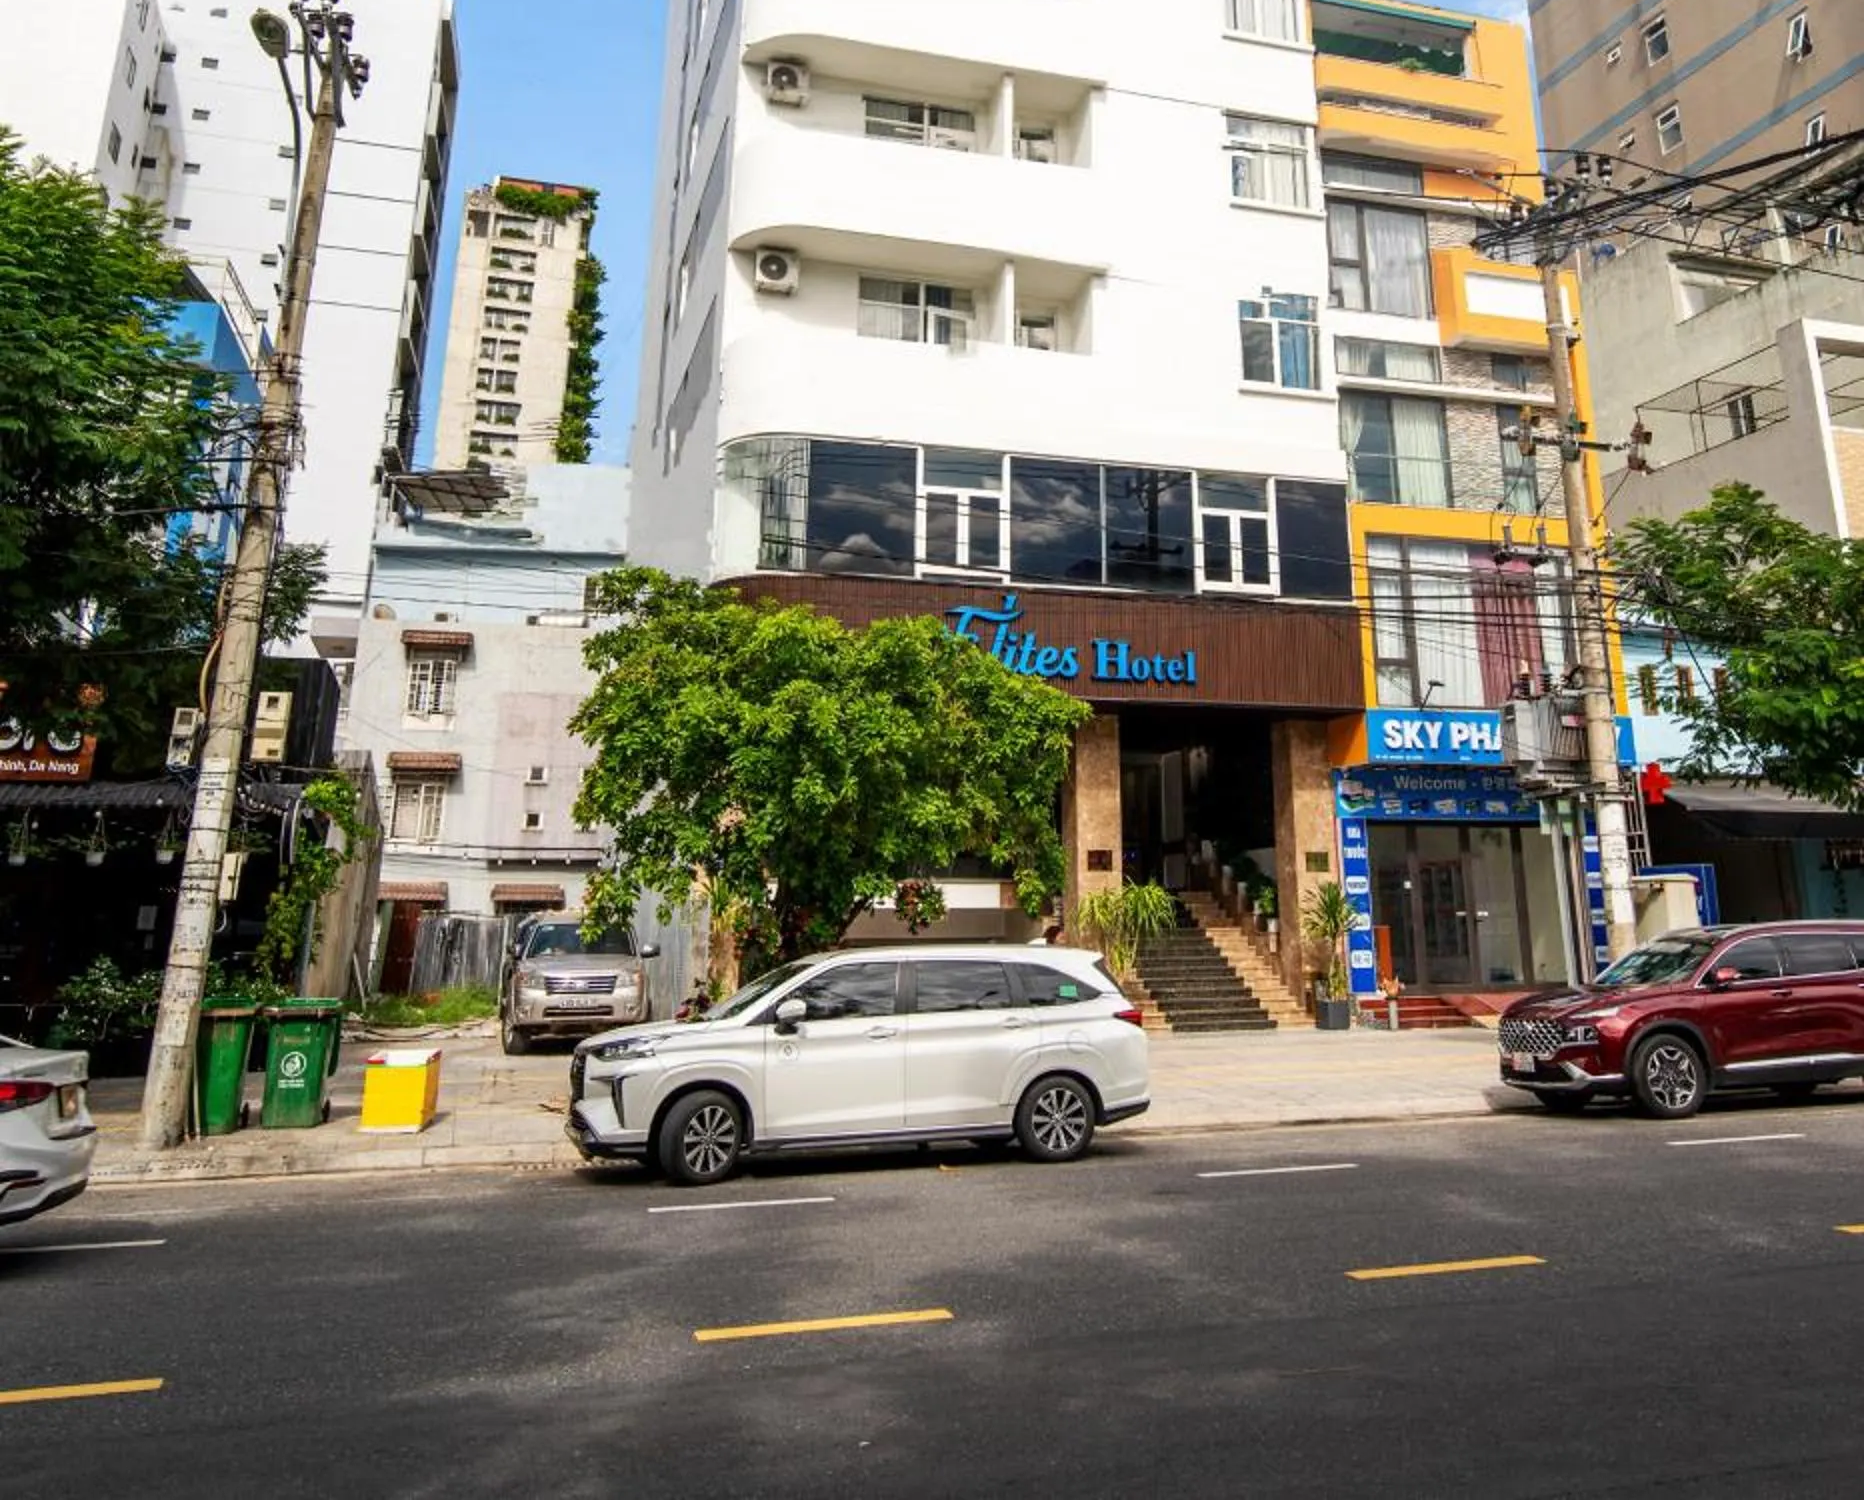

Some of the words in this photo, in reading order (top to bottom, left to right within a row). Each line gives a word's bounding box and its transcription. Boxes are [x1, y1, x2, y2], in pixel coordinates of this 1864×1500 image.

[1091, 637, 1197, 683] Hotel
[1383, 718, 1445, 751] SKY
[1393, 774, 1468, 791] Welcome
